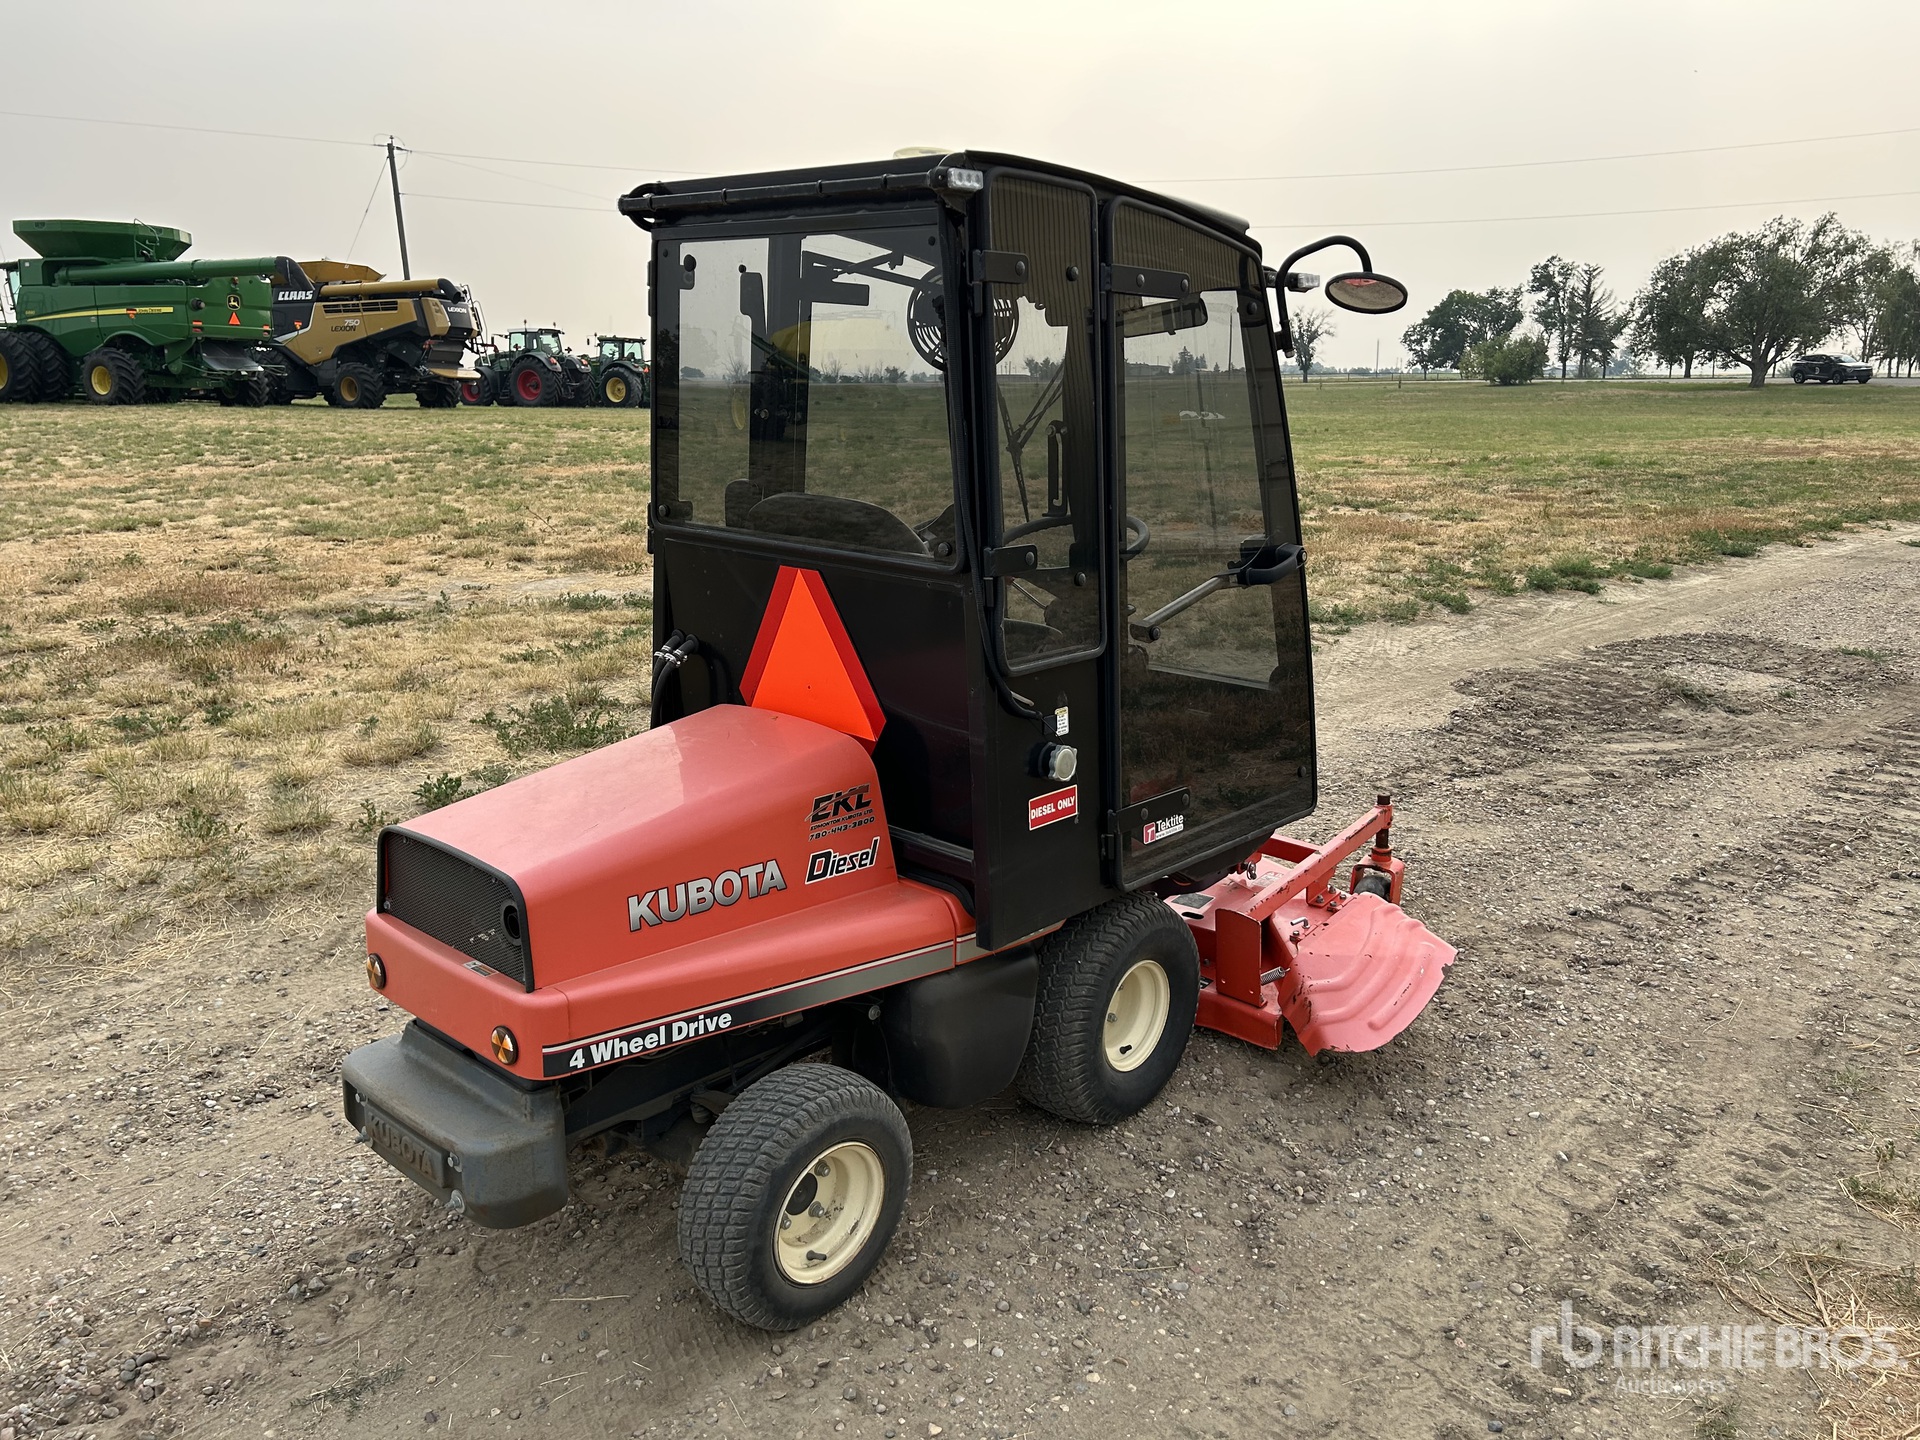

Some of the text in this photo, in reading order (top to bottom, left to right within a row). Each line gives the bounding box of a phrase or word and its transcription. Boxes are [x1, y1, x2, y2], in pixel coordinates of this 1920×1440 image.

[278, 290, 313, 301] CLAAS
[447, 306, 467, 314] LEXION
[805, 783, 872, 823] EKL
[1030, 795, 1076, 820] DIESEL ONLY
[808, 816, 875, 841] 780-443-3800
[810, 818, 840, 831] EDMONTON
[1156, 814, 1184, 832] Tektite
[805, 836, 880, 884] Diesel
[627, 859, 787, 932] KUBOTA
[569, 1012, 732, 1069] 4 Wheel Drive
[367, 1111, 437, 1180] KUBOTA
